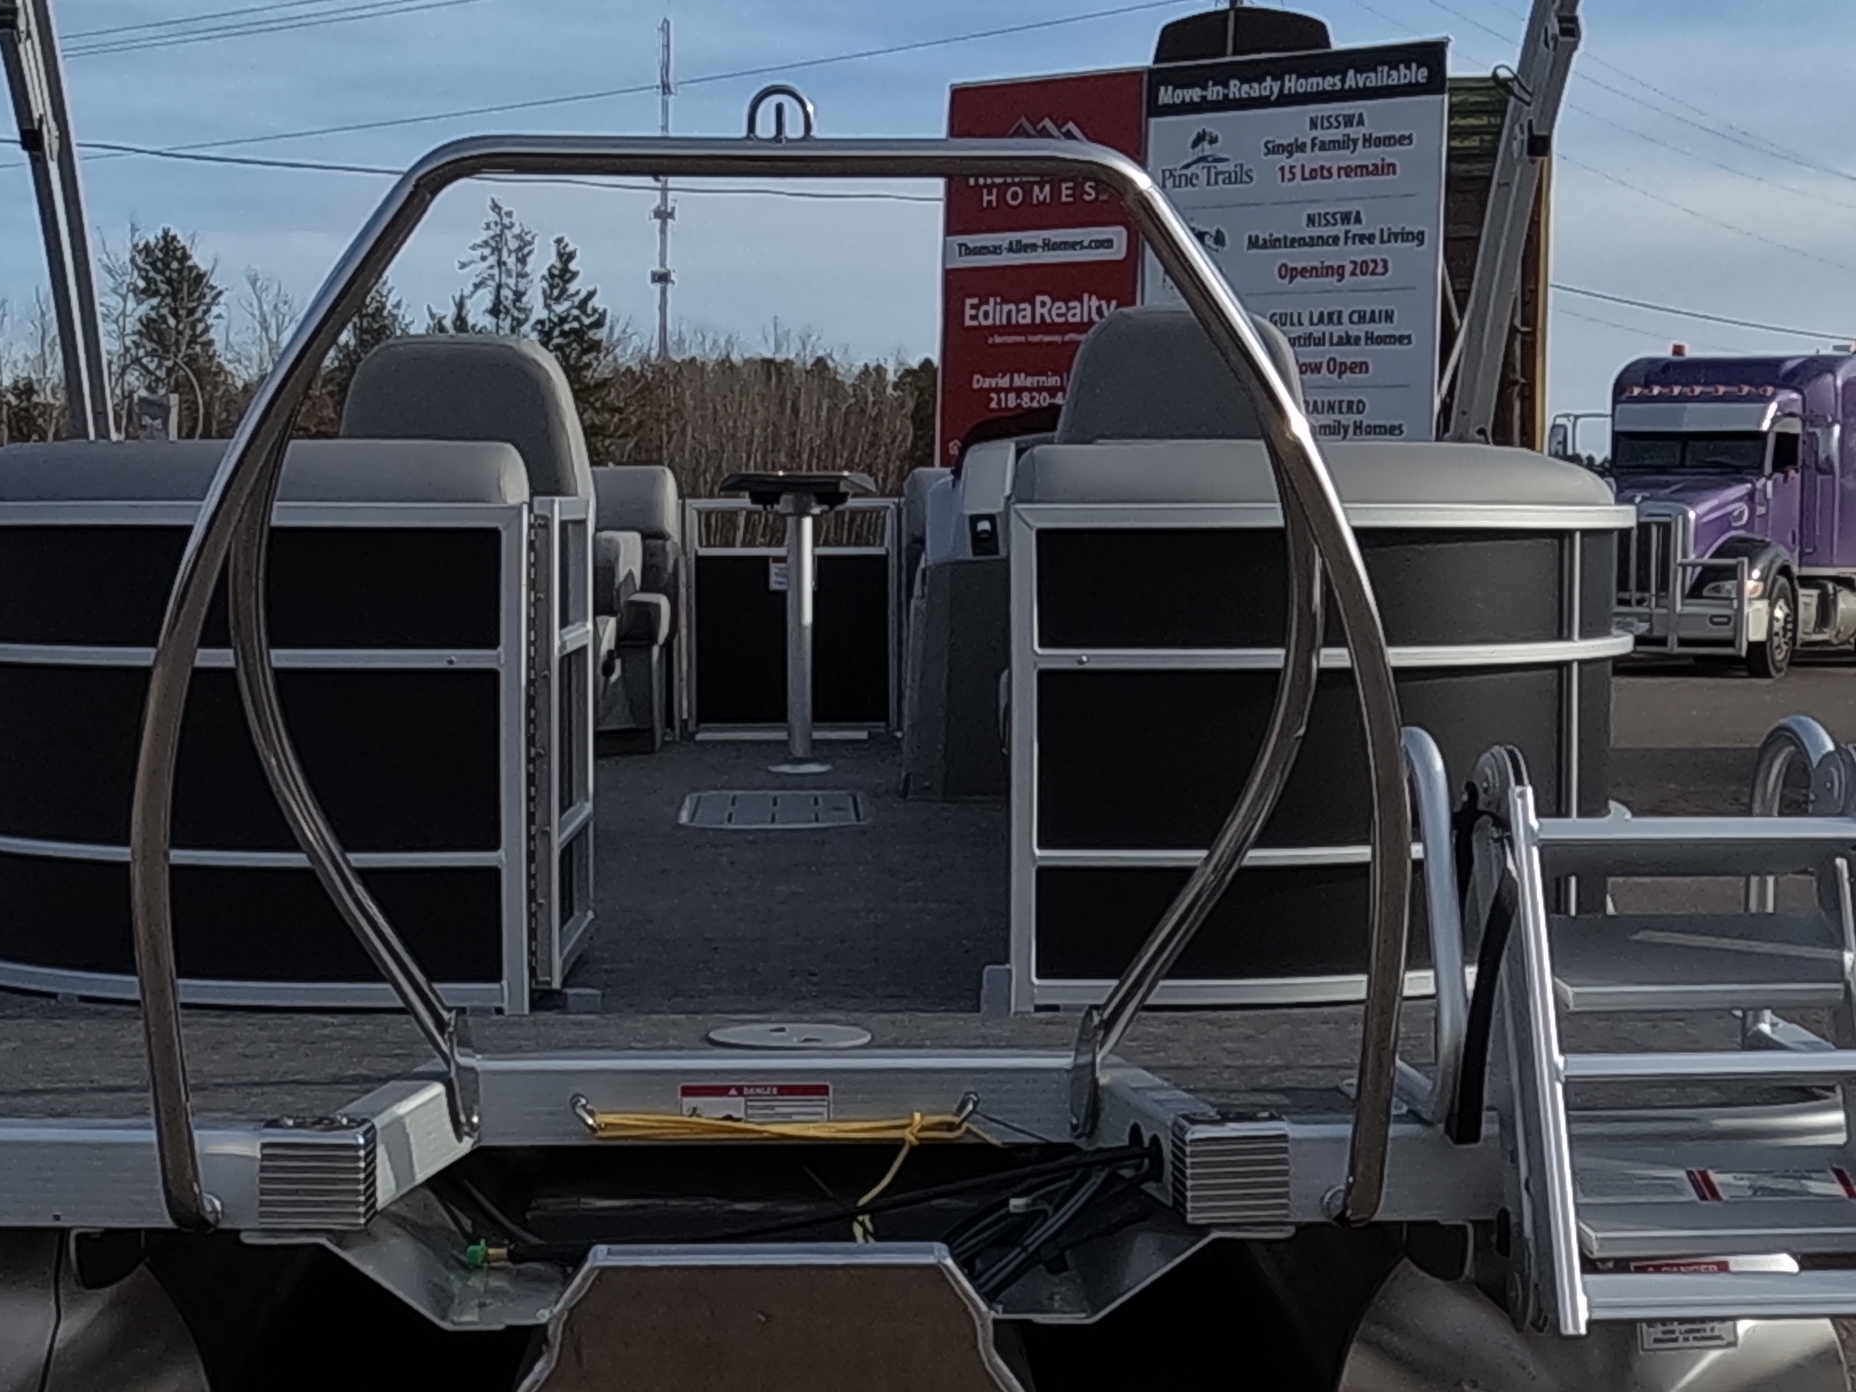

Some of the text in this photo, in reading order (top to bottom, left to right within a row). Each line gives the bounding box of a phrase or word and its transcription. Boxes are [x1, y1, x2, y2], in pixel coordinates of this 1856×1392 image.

[1158, 62, 1429, 105] Move-in-Ready Homes Available
[1309, 112, 1365, 131] NISSWA
[1263, 132, 1413, 158] Single Family Homes
[1160, 163, 1254, 189] Pine Trails
[1278, 157, 1398, 184] 15 Lots remain
[982, 181, 1096, 208] HOMES
[1306, 210, 1363, 228] NISSWA
[1247, 226, 1426, 251] Maintenance Free Living
[1278, 259, 1389, 284] Opening 2023
[1269, 308, 1395, 327] GULL LAKE CHAIN
[1287, 330, 1413, 347] utiful Lake Homes
[1296, 357, 1370, 379] ow Open
[972, 372, 1010, 389] David
[1353, 419, 1404, 437] Homes
